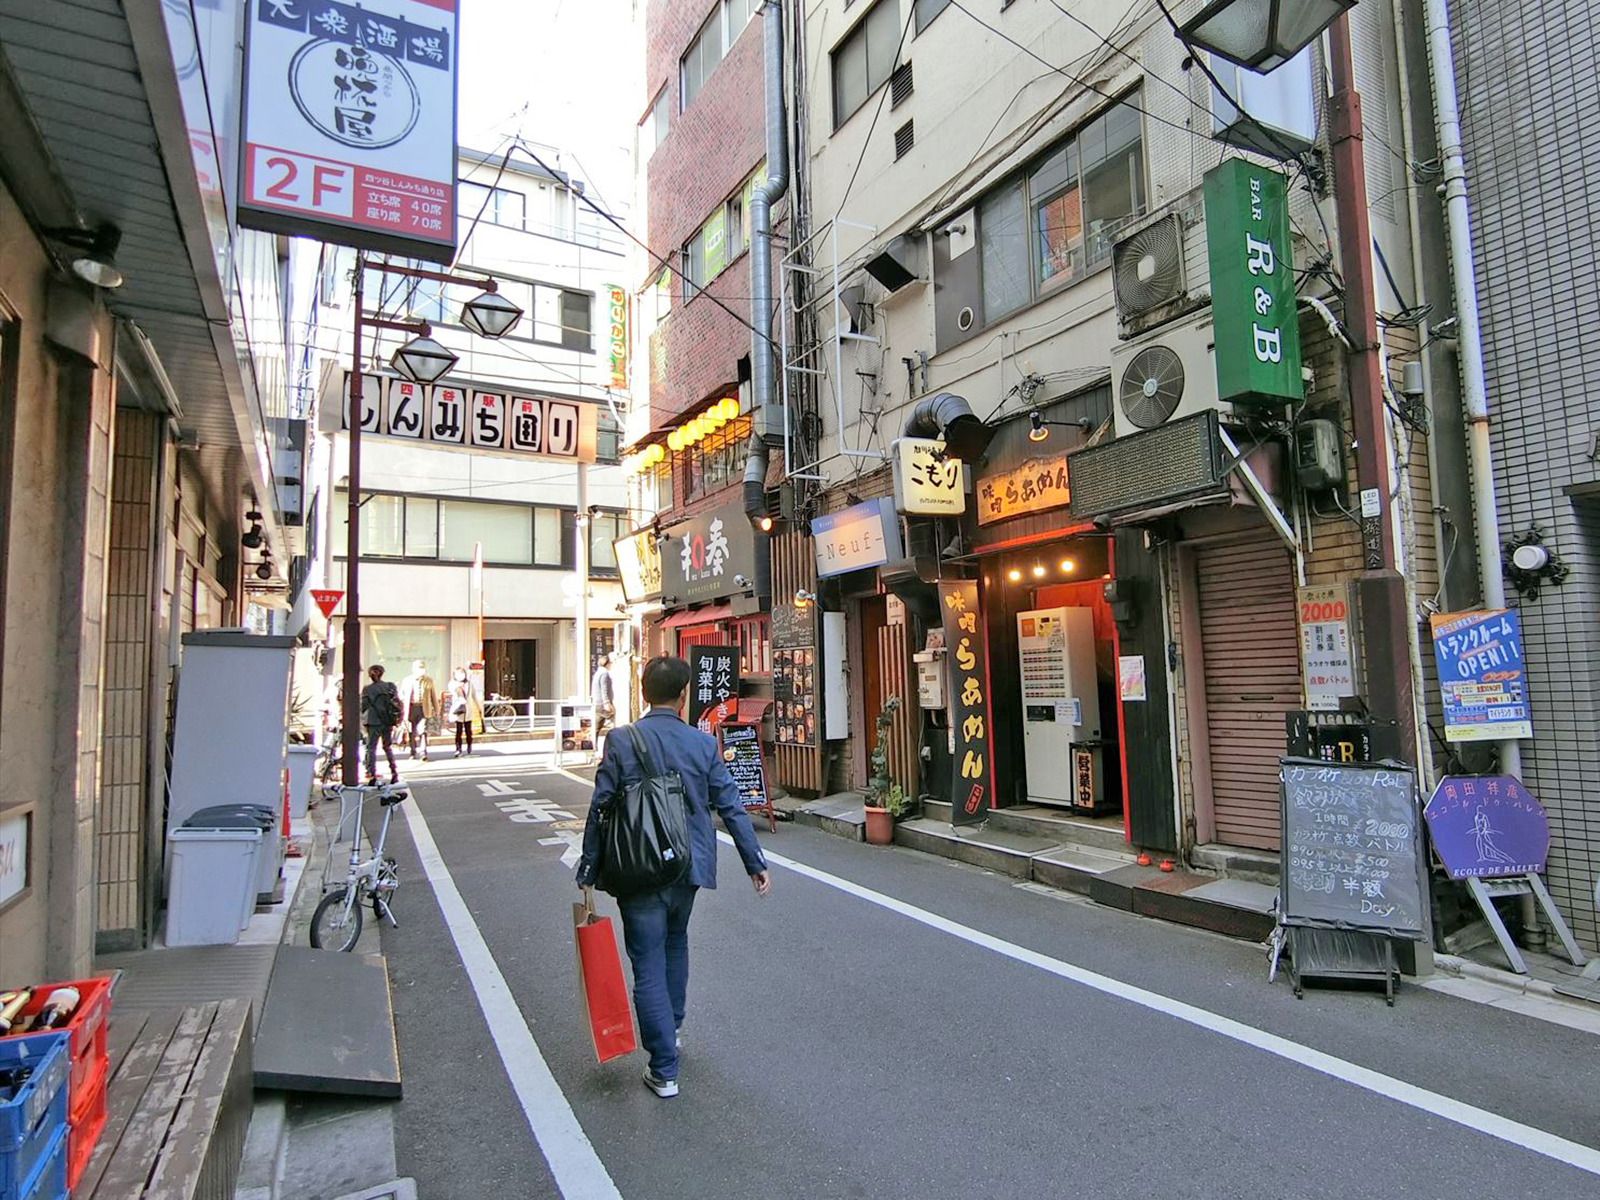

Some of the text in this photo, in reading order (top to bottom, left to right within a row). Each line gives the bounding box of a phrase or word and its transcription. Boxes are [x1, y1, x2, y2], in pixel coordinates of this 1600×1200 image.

[265, 157, 345, 206] 2F
[365, 174, 445, 197] 四ツ谷しんみち通り店
[367, 192, 442, 215] 立ち席 40席
[1249, 177, 1262, 221] BAR
[366, 207, 442, 230] 座り席 70席
[401, 384, 533, 413] 四谷駅前
[910, 462, 958, 490] こもり
[317, 594, 339, 603] 止まれ
[1301, 601, 1345, 623] 2000
[1438, 617, 1513, 660] トランクルーム
[716, 656, 731, 722] 炭火やき
[1309, 675, 1349, 685] 点数バトル
[1338, 741, 1354, 763] R
[1079, 754, 1091, 805] 営業中
[1315, 813, 1349, 826] 1時間
[1333, 832, 1363, 849] 点数
[1454, 864, 1540, 877] ECOLE DE BALLET
[1342, 877, 1386, 899] 半額
[1361, 900, 1395, 917] Day
